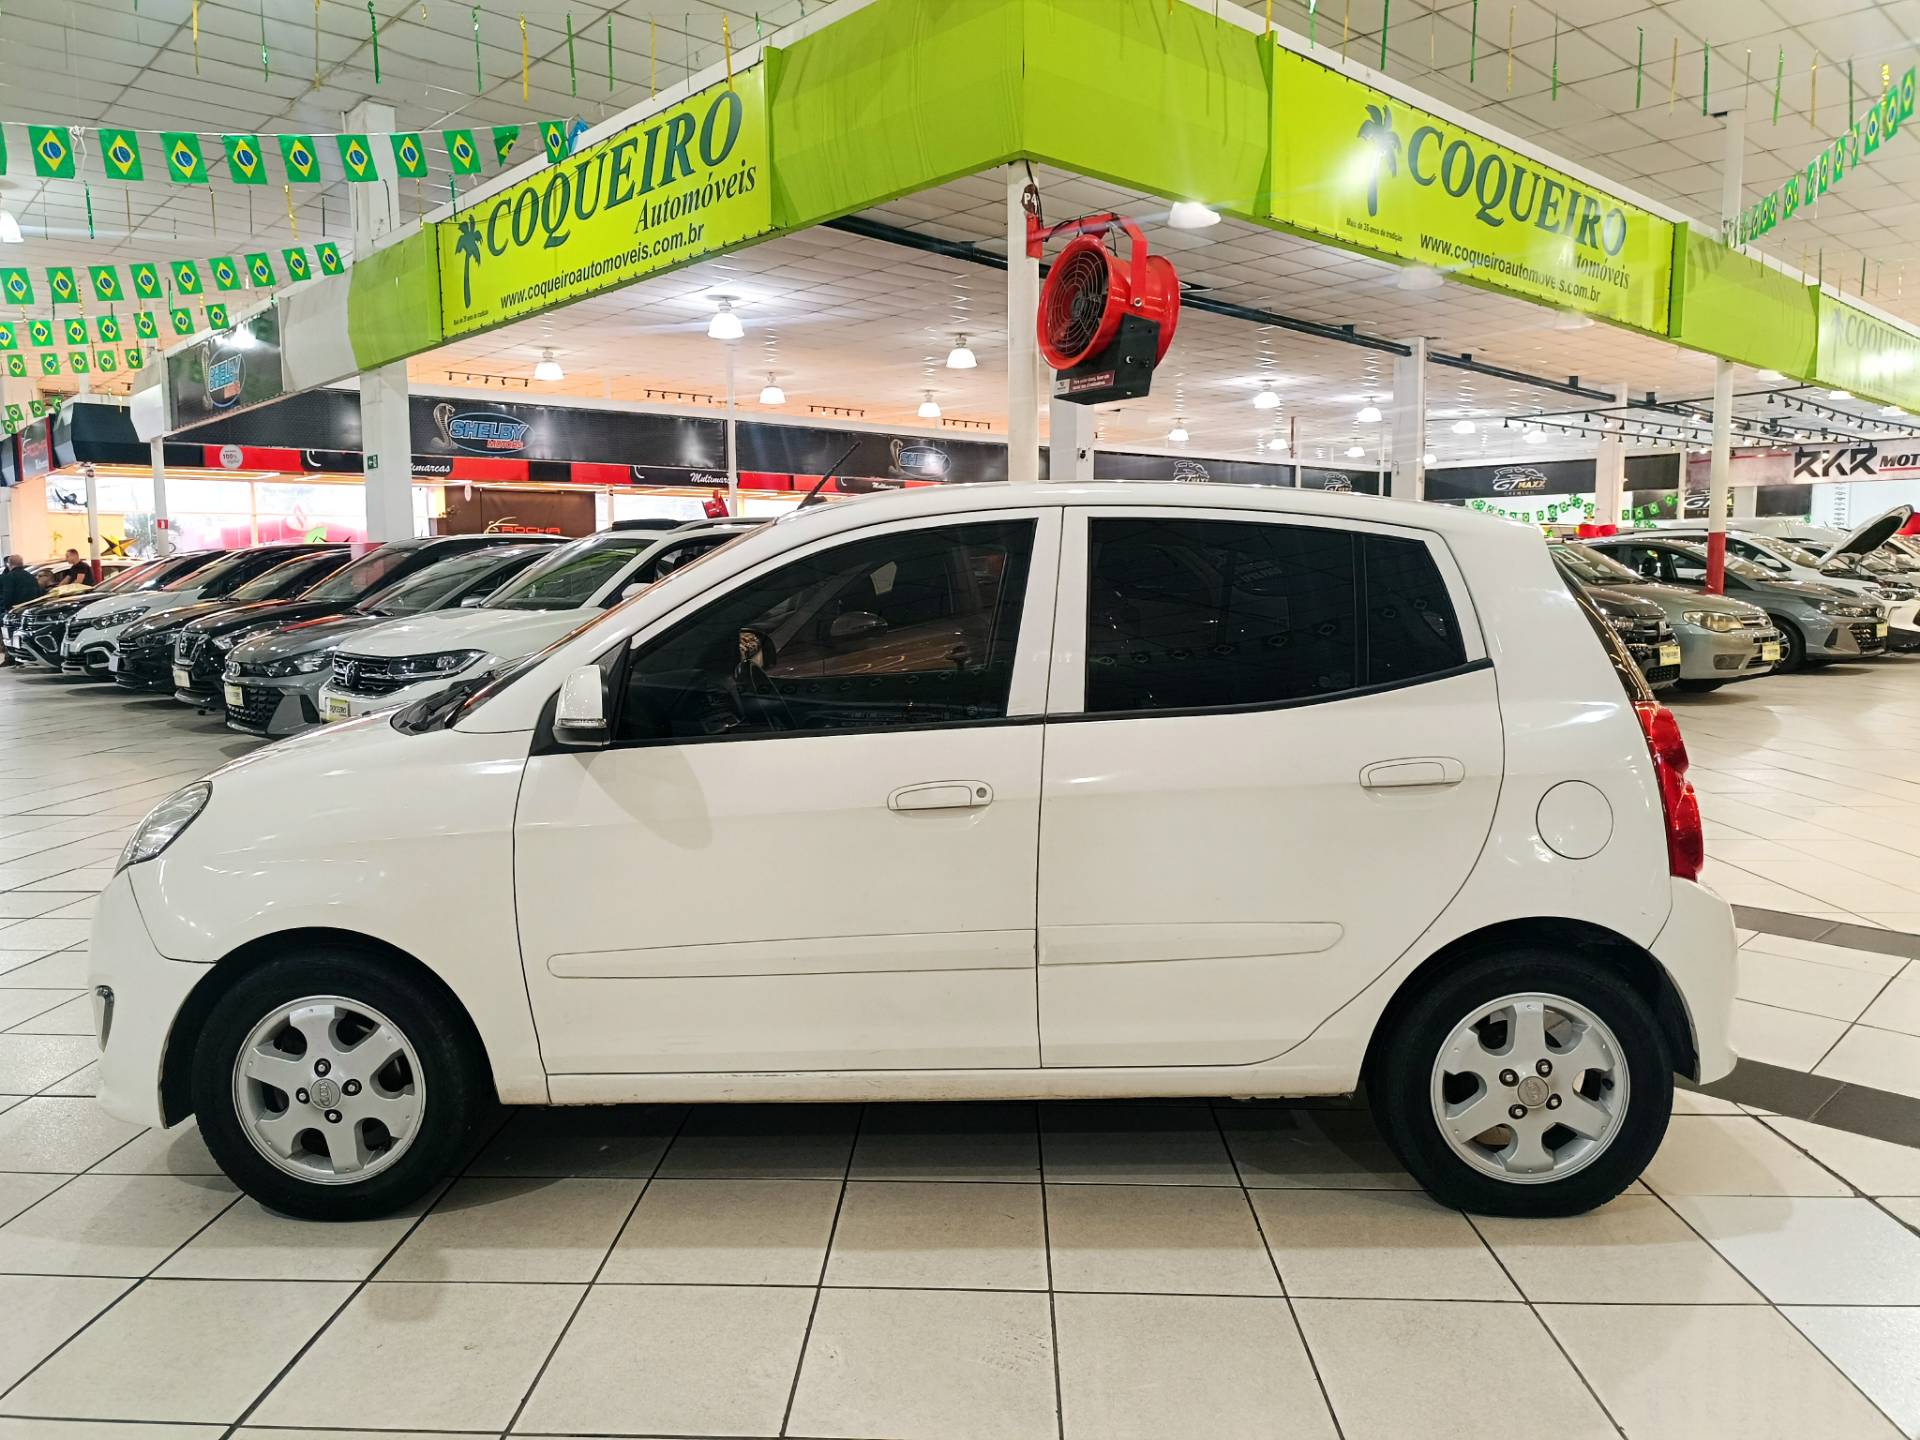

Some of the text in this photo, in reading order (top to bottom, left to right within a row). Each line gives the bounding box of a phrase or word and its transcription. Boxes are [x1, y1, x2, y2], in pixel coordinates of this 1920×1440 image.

[486, 90, 743, 257] COQUEIRO
[634, 159, 757, 234] Automóveis
[1408, 126, 1627, 256] COQUEIRO
[500, 222, 705, 309] www.coqueiroautomoveis.com.br
[450, 419, 529, 440] SHELBY
[1794, 447, 1878, 478] RKR
